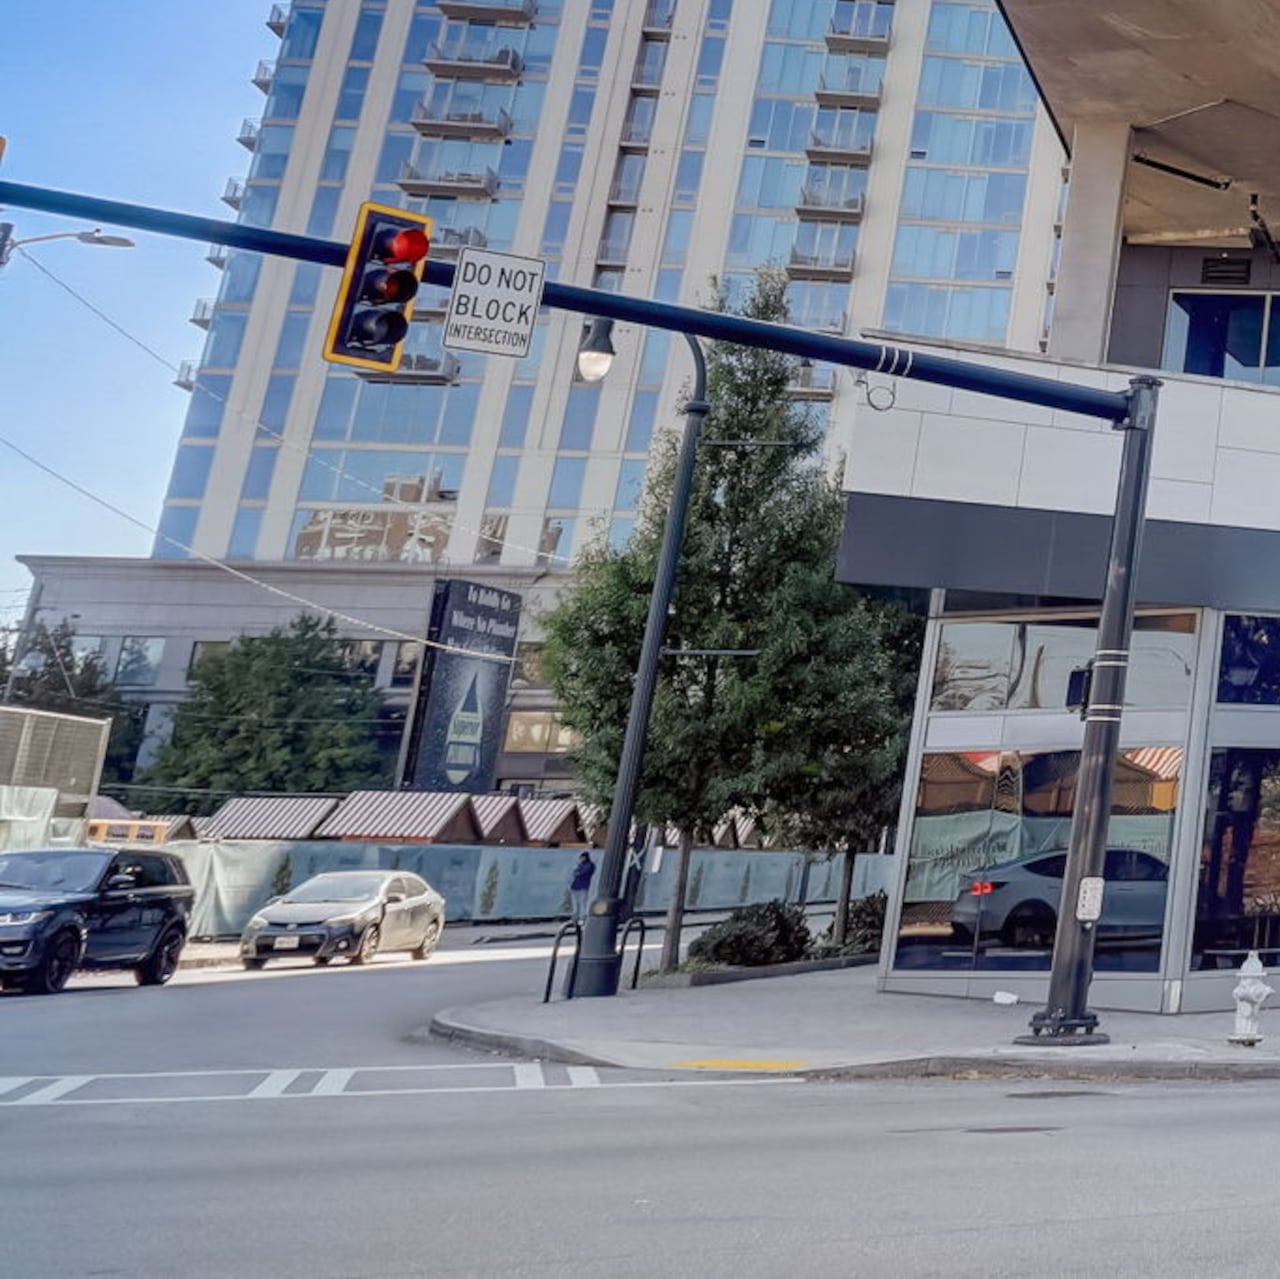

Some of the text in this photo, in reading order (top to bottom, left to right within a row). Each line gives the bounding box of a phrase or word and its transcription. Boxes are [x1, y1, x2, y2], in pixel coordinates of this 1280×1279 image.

[462, 261, 539, 293] DO NOT
[455, 294, 532, 325] BLOCK
[448, 322, 528, 348] INTERSECTION
